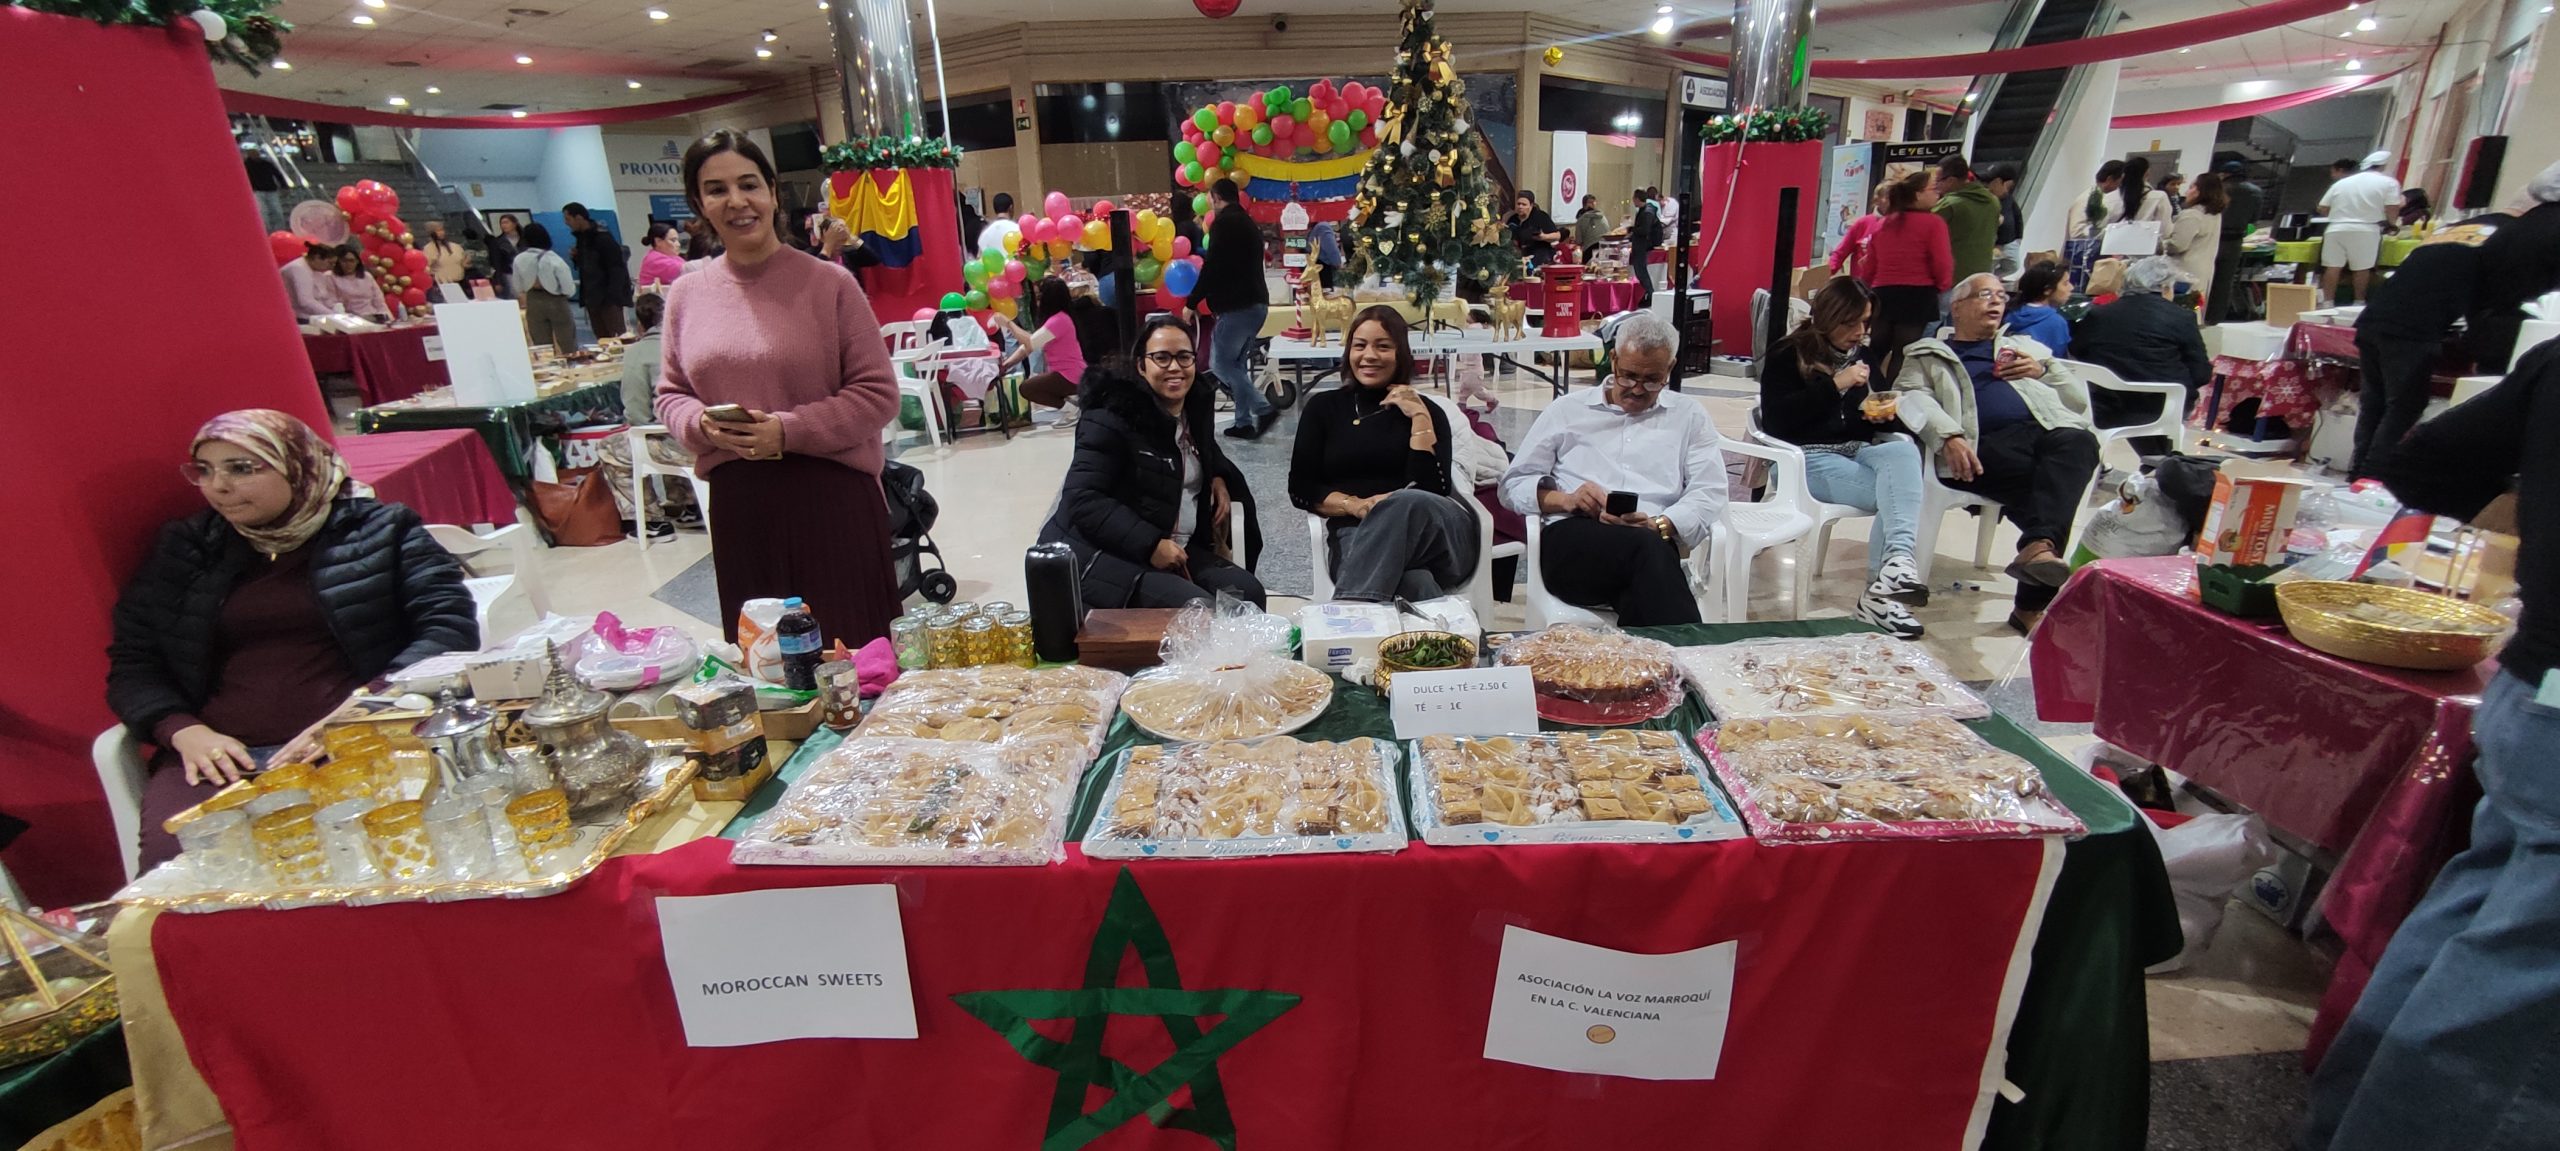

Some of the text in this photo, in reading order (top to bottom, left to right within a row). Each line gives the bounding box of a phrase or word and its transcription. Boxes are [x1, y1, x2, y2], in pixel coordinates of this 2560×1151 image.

[1890, 145, 1959, 156] LEVEL UP
[620, 162, 682, 175] PROMO
[2258, 504, 2277, 534] MINI
[1413, 685, 1444, 694] DULCE
[1458, 681, 1469, 692] TÉ
[1479, 681, 1500, 691] 2.50
[1415, 703, 1427, 712] TÉ
[1450, 701, 1463, 711] 1€
[702, 973, 884, 996] MOROCCAN SWEETS
[1517, 973, 1713, 1004] ASOCIACIÓN LA VOZ MARROQUÍ
[1530, 993, 1661, 1022] EN LA C. VALENCIANA
